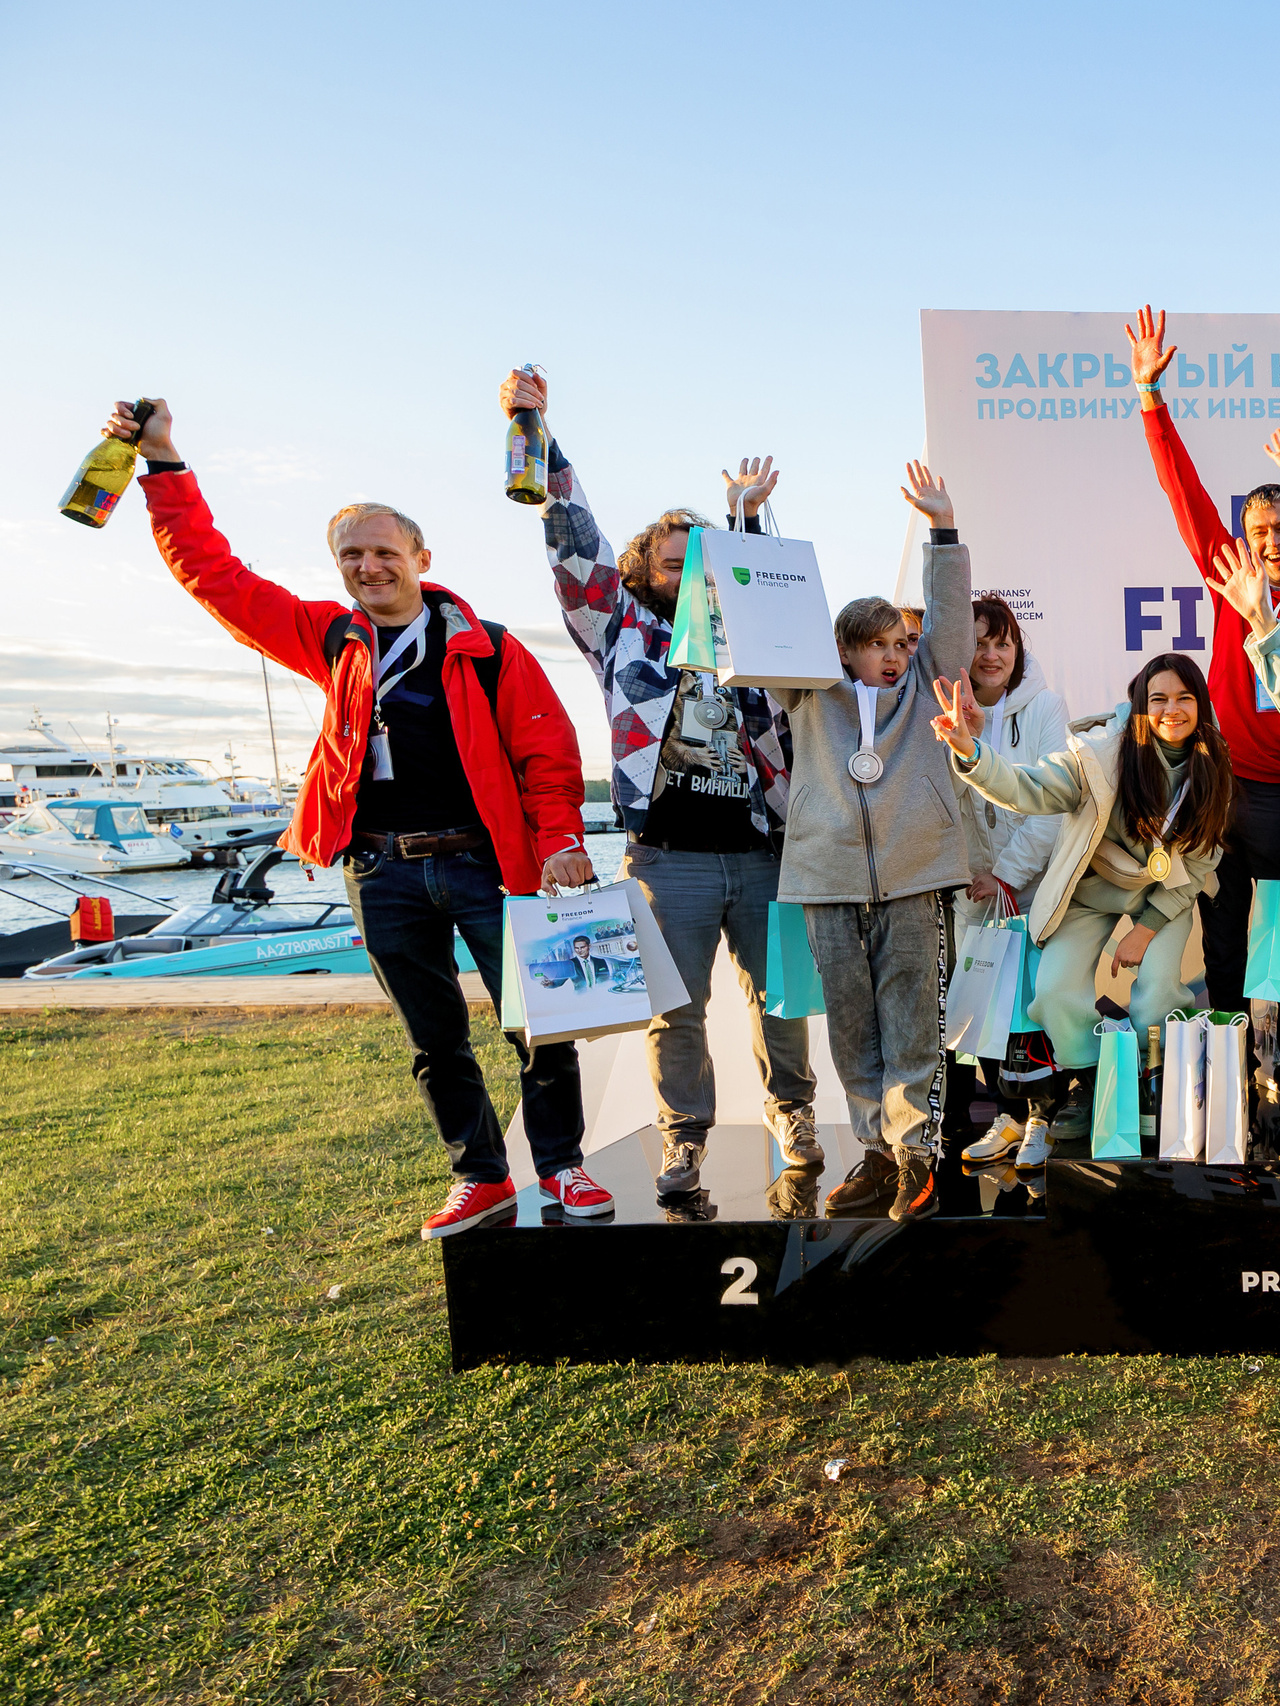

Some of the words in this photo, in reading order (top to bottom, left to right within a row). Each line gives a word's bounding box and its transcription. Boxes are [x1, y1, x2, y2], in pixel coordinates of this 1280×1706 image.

[977, 398, 1200, 421] ПРОДВИНУХ
[755, 571, 807, 583] FREEDOM
[756, 579, 790, 589] finance
[1016, 612, 1044, 620] ВСЕМ
[706, 708, 716, 719] 2
[861, 761, 871, 772] 2
[690, 774, 752, 799] ВИНИШК
[1155, 861, 1163, 872] 1
[561, 909, 594, 918] FREEDOM
[256, 933, 350, 960] AA2780RUS77
[720, 1256, 759, 1305] 2
